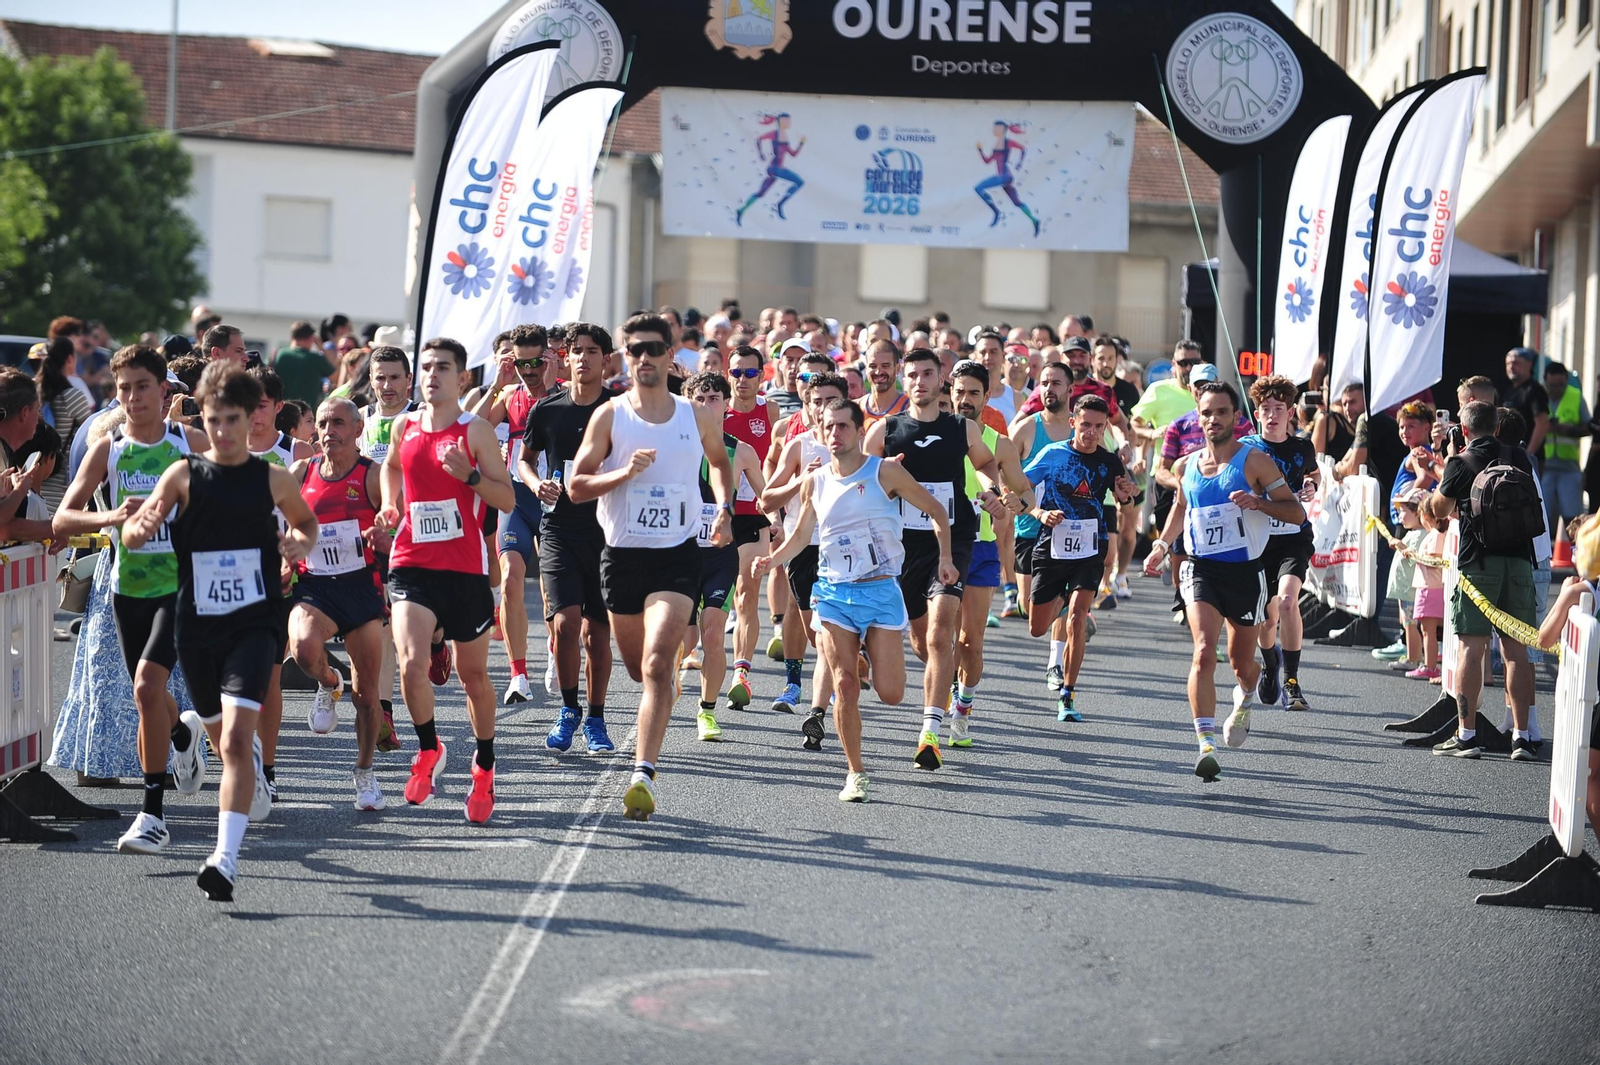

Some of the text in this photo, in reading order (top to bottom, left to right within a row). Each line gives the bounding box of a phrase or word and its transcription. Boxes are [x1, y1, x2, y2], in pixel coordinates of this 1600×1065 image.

[585, 10, 603, 29] DE
[832, 0, 1092, 43] OURENSE
[911, 55, 1011, 76] Deportes
[1176, 21, 1293, 117] CONSELLO MUNICIPAL DE DEPORTES
[895, 134, 936, 142] OURENSE
[1208, 119, 1262, 136] OURENSE
[449, 157, 497, 234] chc
[863, 195, 920, 216] 2026
[518, 178, 558, 248] chc
[1388, 186, 1432, 262] chc
[1429, 190, 1450, 266] energía
[1289, 205, 1313, 267] chc
[420, 517, 449, 535] 1004
[637, 507, 670, 528] 423
[1064, 537, 1081, 552] 94
[1206, 526, 1224, 546] 27
[322, 546, 339, 566] 111
[843, 554, 852, 573] 7
[208, 579, 244, 603] 455
